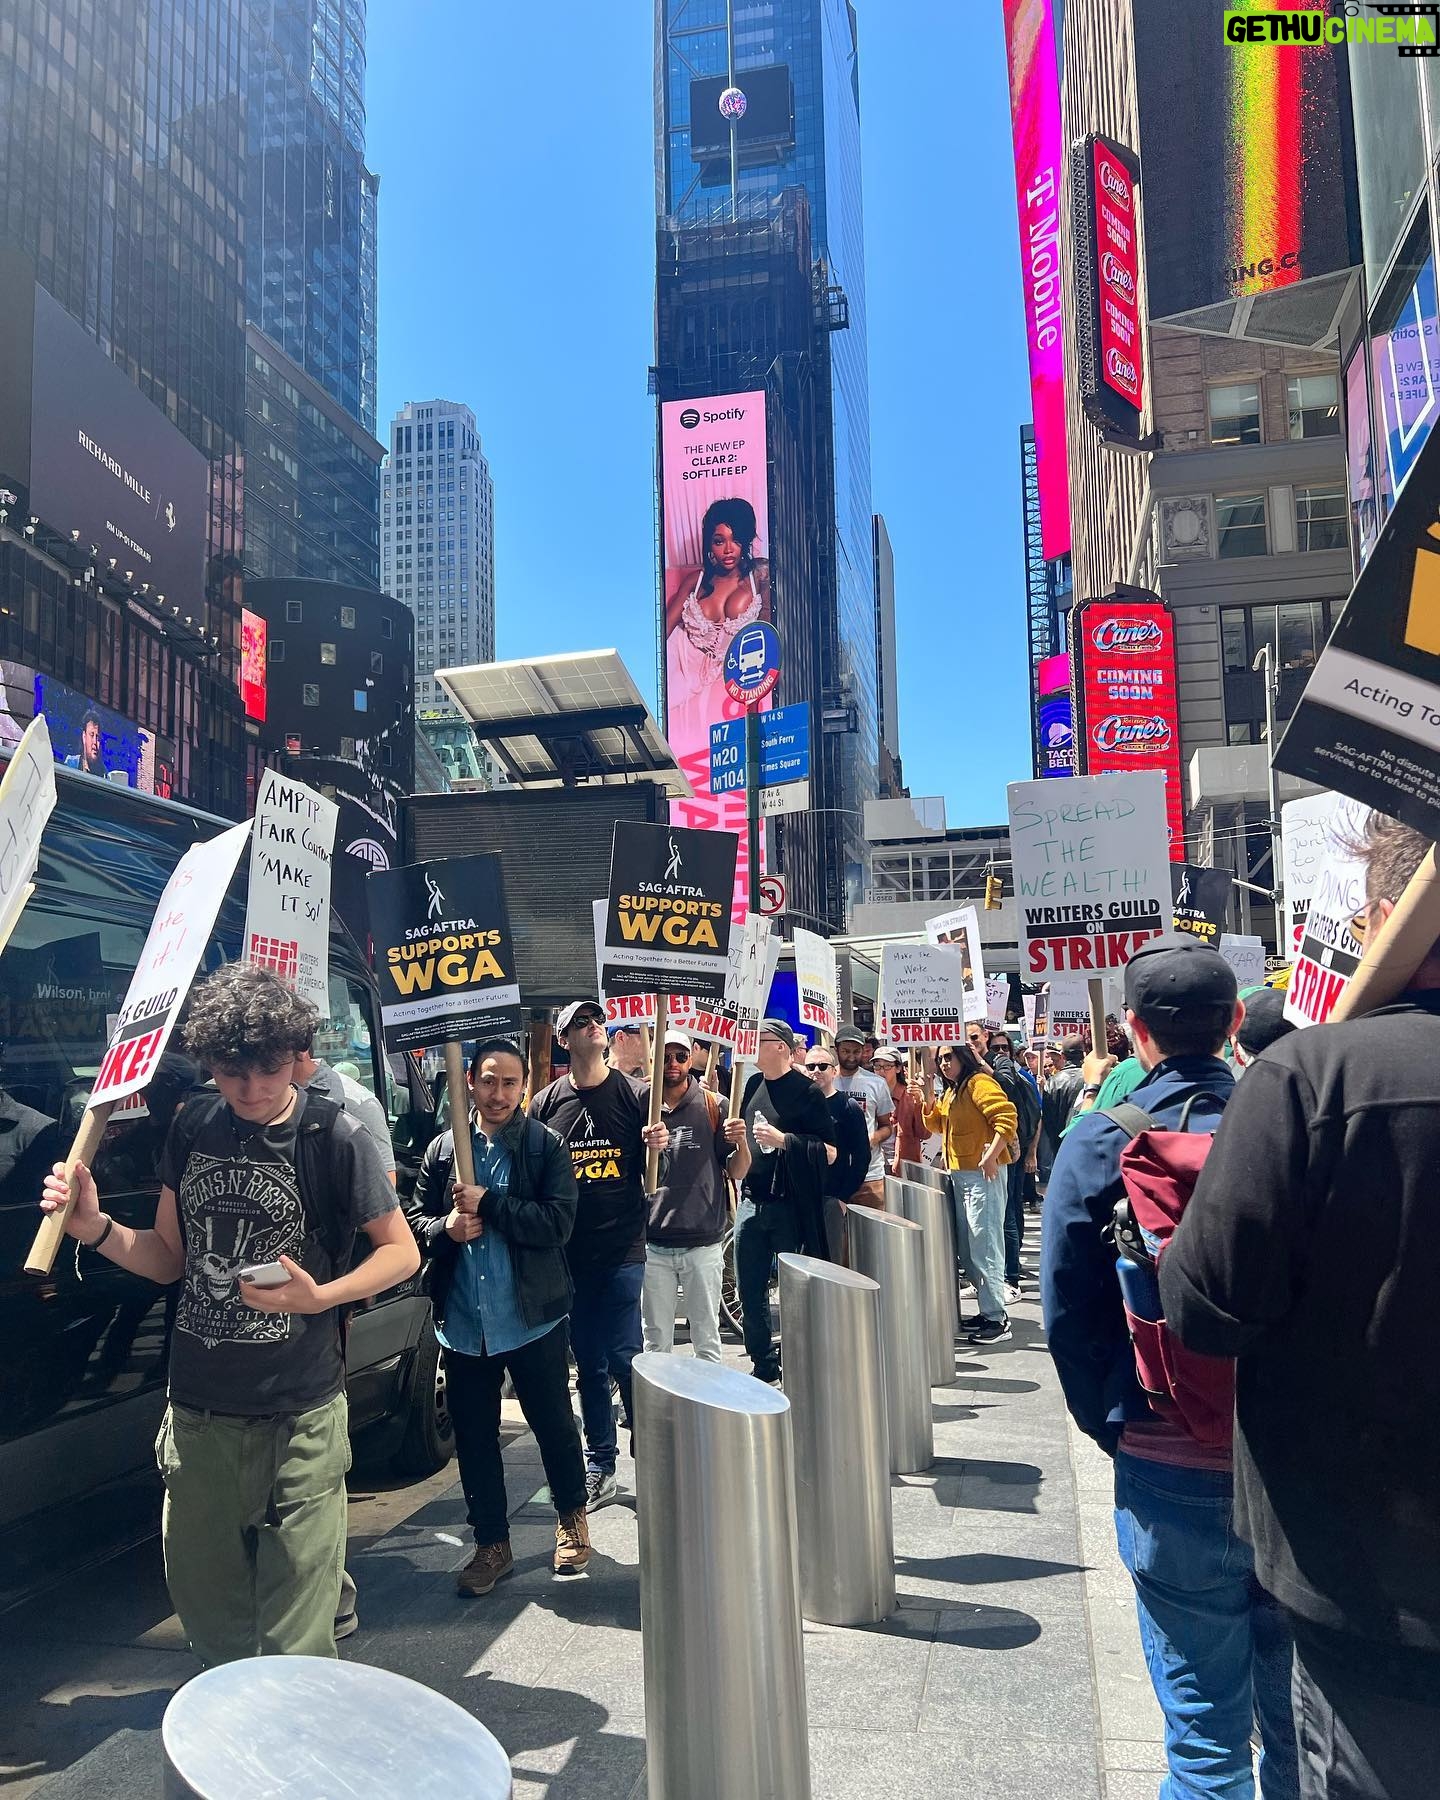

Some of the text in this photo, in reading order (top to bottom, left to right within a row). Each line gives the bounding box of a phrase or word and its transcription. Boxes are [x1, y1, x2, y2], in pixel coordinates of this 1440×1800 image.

[1101, 203, 1131, 243] COMING
[1106, 223, 1127, 255] SOON
[1105, 299, 1135, 336] COMING
[1110, 318, 1131, 348] SOON
[703, 408, 745, 423] Spotify
[684, 440, 745, 455] THE NEW EP
[78, 429, 151, 504] RICHARD MILLE
[691, 454, 737, 467] CLEAR 2:
[682, 465, 748, 480] SOFT LIFE EP
[1096, 619, 1161, 650] Cane's
[729, 674, 774, 700] NO STANDING
[1097, 669, 1163, 685] COMING
[1108, 685, 1153, 700] SOON
[1344, 677, 1414, 717] Acting
[761, 711, 784, 724] W 14 St
[712, 724, 730, 744] M7
[761, 735, 795, 749] South Ferry
[1097, 716, 1170, 749] Cane's
[712, 746, 738, 768] M20
[761, 758, 801, 773] Times Square
[1380, 749, 1436, 780] No dispute
[712, 768, 745, 791] M104
[1314, 746, 1427, 800] services, or to refuse to
[1393, 767, 1402, 776] is
[1403, 772, 1422, 785] not
[762, 801, 768, 810] W
[777, 798, 784, 807] St
[767, 790, 774, 798] Av
[1012, 798, 1136, 837] SPREAD
[259, 814, 297, 844] FAIR
[1033, 835, 1097, 863] THE
[1019, 868, 1148, 897] WEALTH!
[281, 895, 300, 912] IT
[618, 894, 723, 918] SUPPORTS
[1025, 898, 1161, 925] WRITERS GUILD
[617, 911, 720, 949] WGA
[1086, 921, 1105, 934] ON
[1172, 917, 1217, 936] PORTS
[387, 929, 502, 963] SUPPORTS
[613, 953, 634, 961] Acting
[635, 954, 663, 963] Together
[697, 960, 718, 968] Future
[388, 949, 506, 995] WGA
[37, 983, 86, 1001] Wilson,
[133, 986, 179, 1021] GUILD
[393, 1009, 416, 1018] Acting
[418, 1003, 444, 1014] Together
[463, 997, 484, 1006] Better
[486, 993, 509, 1001] Future
[713, 1007, 724, 1016] ON
[890, 1007, 958, 1017] WRITERS GUILD
[1053, 1010, 1084, 1018] WRITERS
[891, 1023, 960, 1042] STRIKE!
[185, 1169, 296, 1223] GUNS N' ROSES
[236, 1311, 270, 1320] CITY
